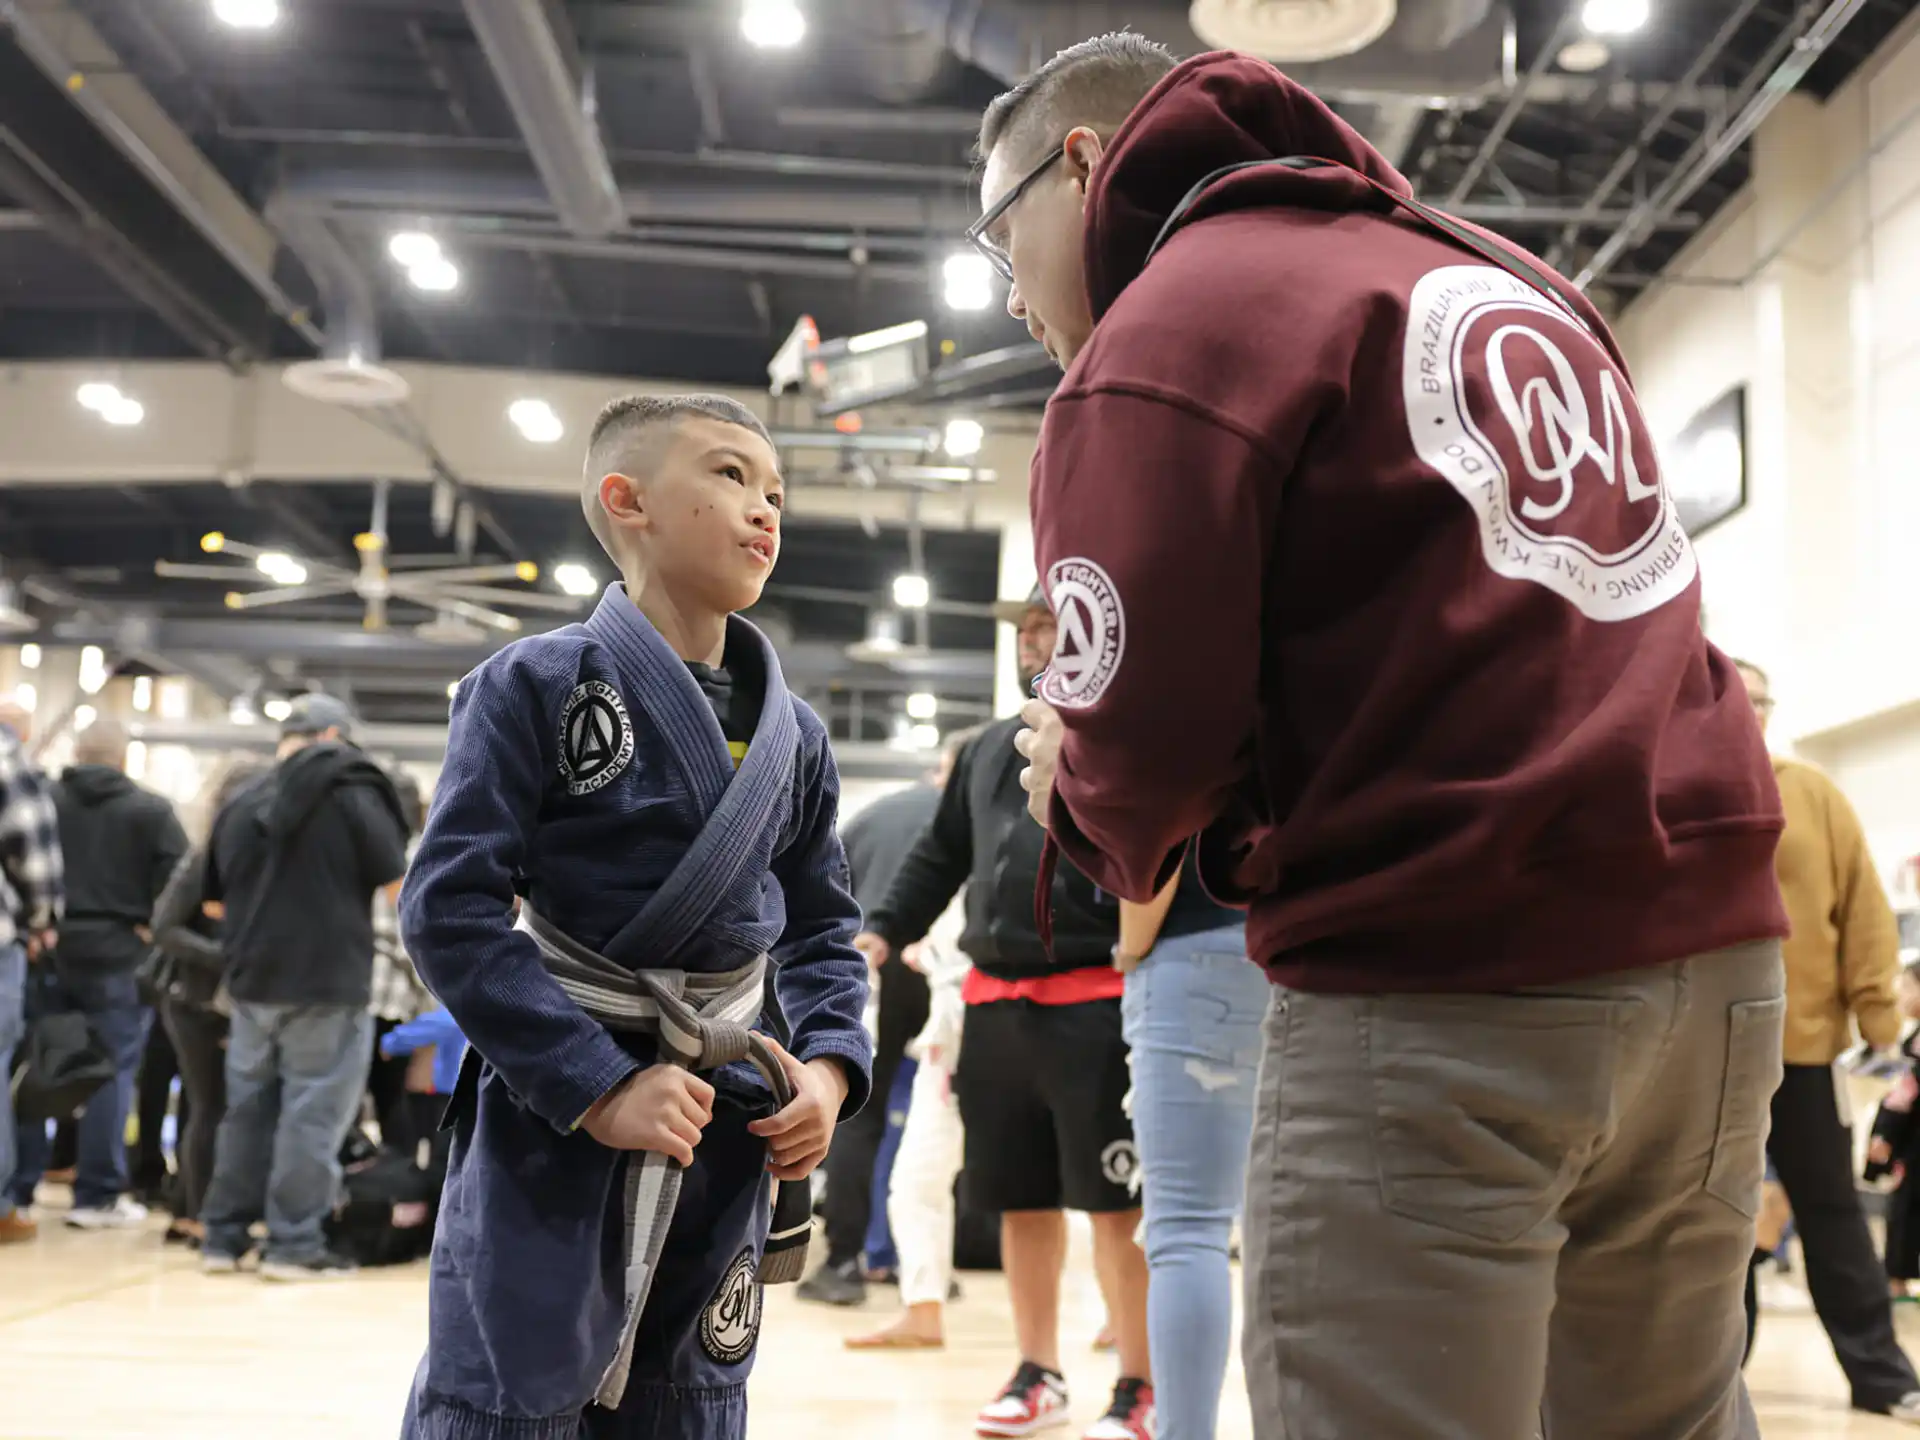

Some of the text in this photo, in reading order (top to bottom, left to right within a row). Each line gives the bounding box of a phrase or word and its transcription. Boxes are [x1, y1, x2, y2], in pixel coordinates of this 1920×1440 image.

[1420, 286, 1463, 394] BRAZILIAN
[1444, 443, 1587, 590] TAE KWON DO
[1062, 565, 1118, 629] FIGHTER
[1606, 530, 1686, 600] STRIKING
[585, 683, 633, 733] FIGHTER
[583, 738, 633, 793] ACADEMY
